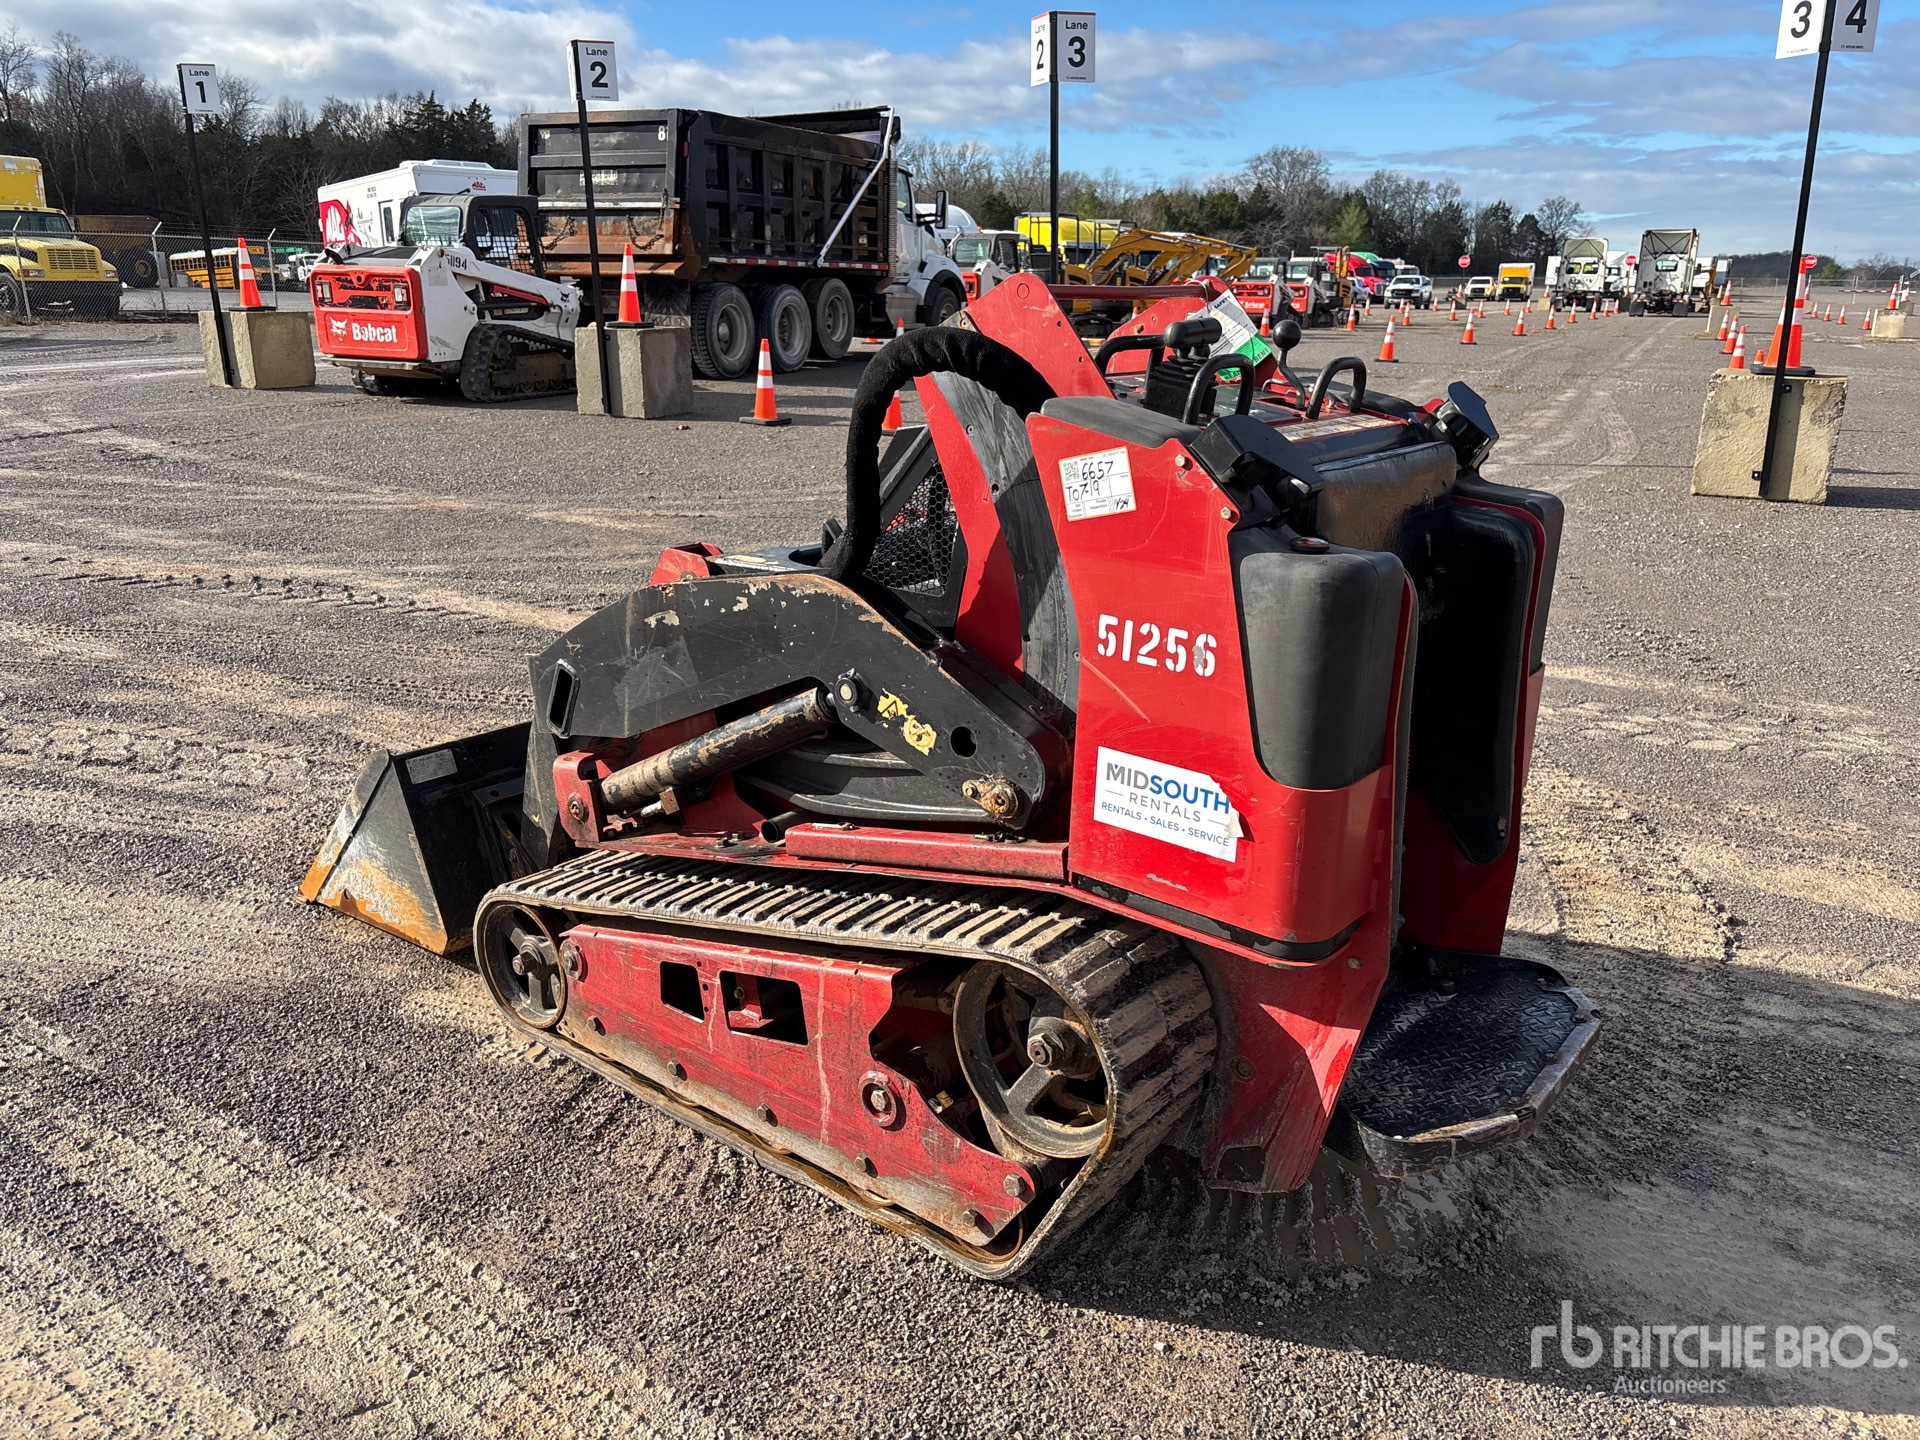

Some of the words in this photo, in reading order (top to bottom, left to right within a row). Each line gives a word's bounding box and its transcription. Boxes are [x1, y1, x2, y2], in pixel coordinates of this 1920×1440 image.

[1065, 20, 1088, 29] Lane
[1790, 0, 1812, 38] 3
[1845, 0, 1867, 33] 4
[586, 47, 608, 56] Lane
[1036, 39, 1044, 70] 2
[1068, 36, 1085, 68] 3
[590, 61, 608, 88] 2
[195, 81, 206, 103] 1
[1214, 295, 1231, 309] SAFETY
[352, 322, 398, 343] Bobcat
[1254, 348, 1269, 363] RENT
[1082, 461, 1113, 480] 6657
[1097, 613, 1217, 677] 51256
[1106, 762, 1230, 815] MIDSOUTH
[1129, 792, 1201, 823] RENTALS
[1101, 801, 1142, 821] RENTALS
[1150, 816, 1180, 832] SALES
[1188, 827, 1229, 847] SERVICE
